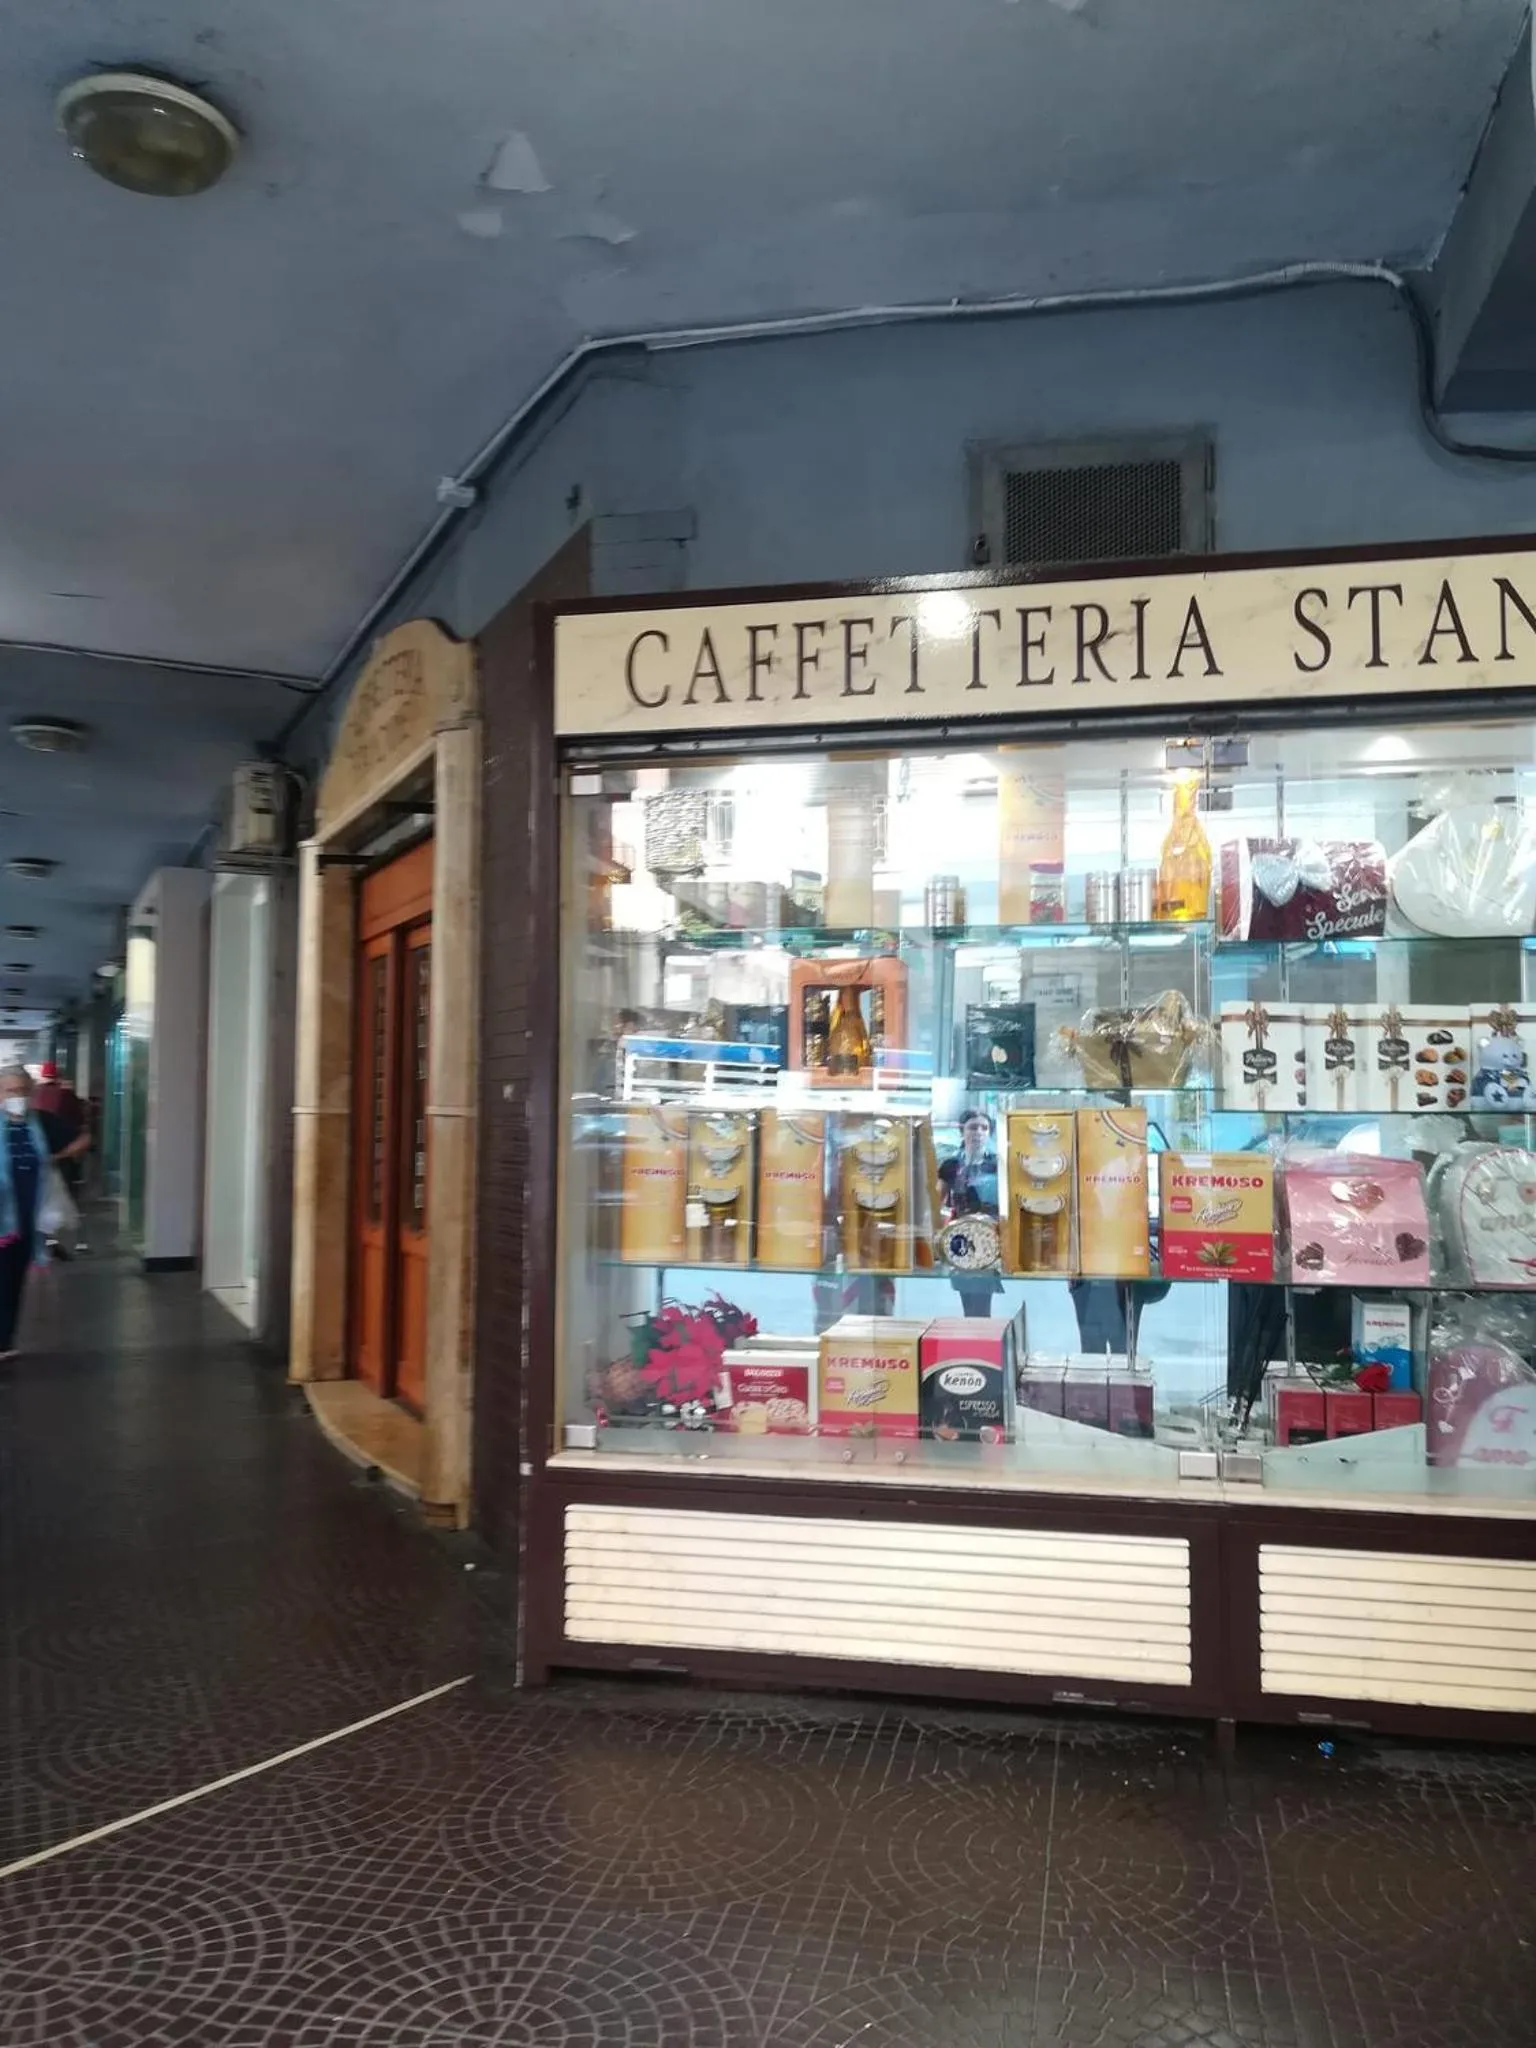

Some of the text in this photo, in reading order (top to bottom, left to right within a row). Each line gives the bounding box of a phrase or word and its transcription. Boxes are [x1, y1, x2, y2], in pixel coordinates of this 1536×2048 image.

[625, 576, 1536, 708] CAFFETTERIA STAN
[1171, 1173, 1265, 1189] KREMUSO
[826, 1355, 911, 1370] KREMUSO
[943, 1374, 982, 1388] kenon
